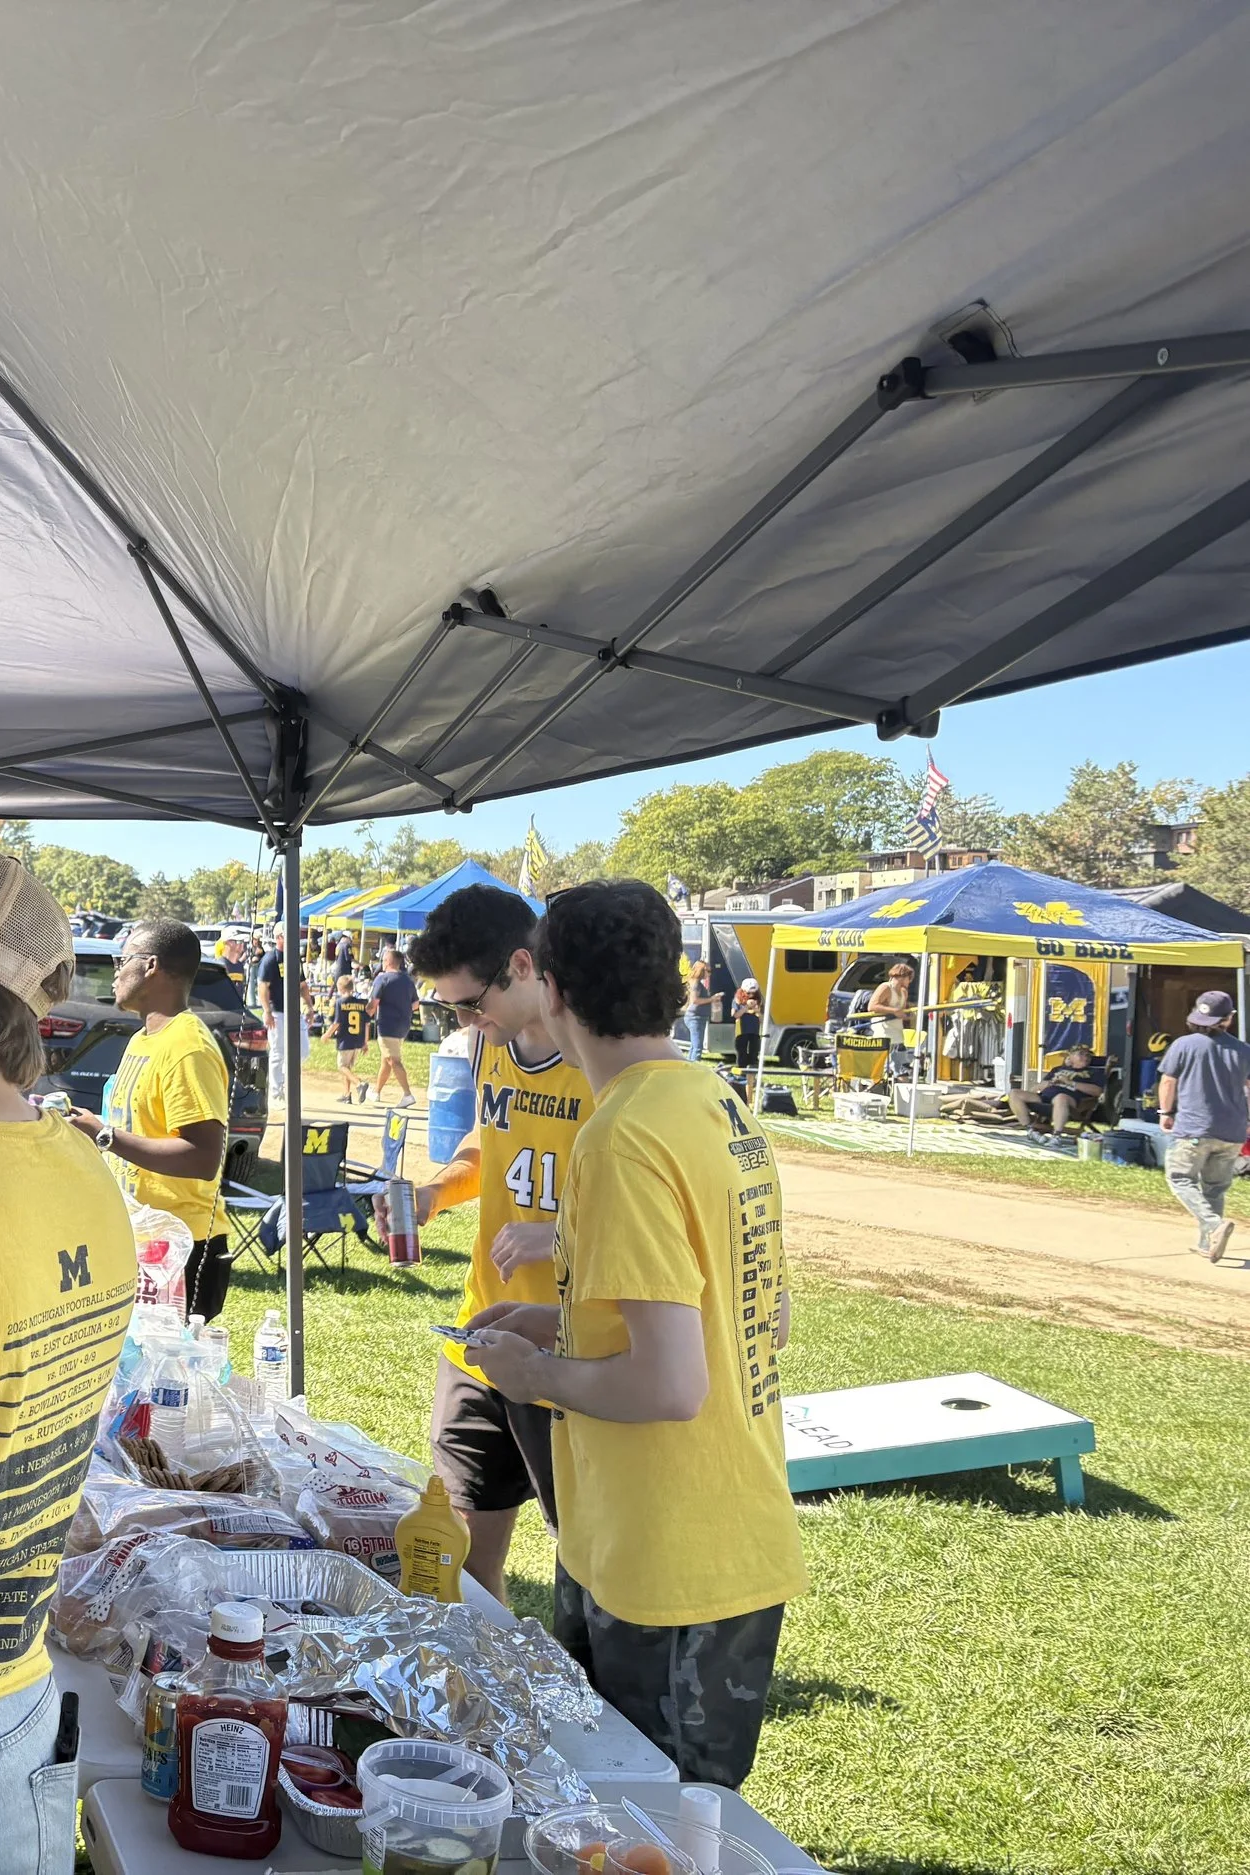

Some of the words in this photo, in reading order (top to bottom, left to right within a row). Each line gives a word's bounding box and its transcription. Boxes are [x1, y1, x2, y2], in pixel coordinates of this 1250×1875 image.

[348, 1010, 360, 1034] 9
[1048, 997, 1087, 1023] M
[843, 1037, 883, 1048] MICHIGAN
[481, 1081, 581, 1132] MICHIGAN
[302, 1128, 332, 1154] M
[505, 1147, 558, 1212] 41
[58, 1244, 92, 1293] M
[7, 1319, 28, 1335] 2023
[29, 1304, 66, 1328] MICHIGAN
[66, 1293, 104, 1314] FOOTBALL
[30, 1350, 41, 1359] vs.
[43, 1337, 61, 1355] EAST
[63, 1322, 102, 1346] CAROLINA
[108, 1315, 120, 1329] 9/2
[59, 1358, 79, 1376] UNLV
[84, 1351, 96, 1364] 9/9
[28, 1390, 66, 1417] BOWLING
[68, 1379, 93, 1398] GREEN
[24, 1433, 34, 1443] vs.
[36, 1413, 74, 1439] RUTGERS
[14, 1464, 24, 1475] at
[27, 1443, 68, 1473] NEBRASKA
[3, 1512, 13, 1521] at
[30, 1538, 58, 1557] STATE
[36, 1559, 59, 1570] 11/4
[220, 1723, 245, 1735] HEINZ
